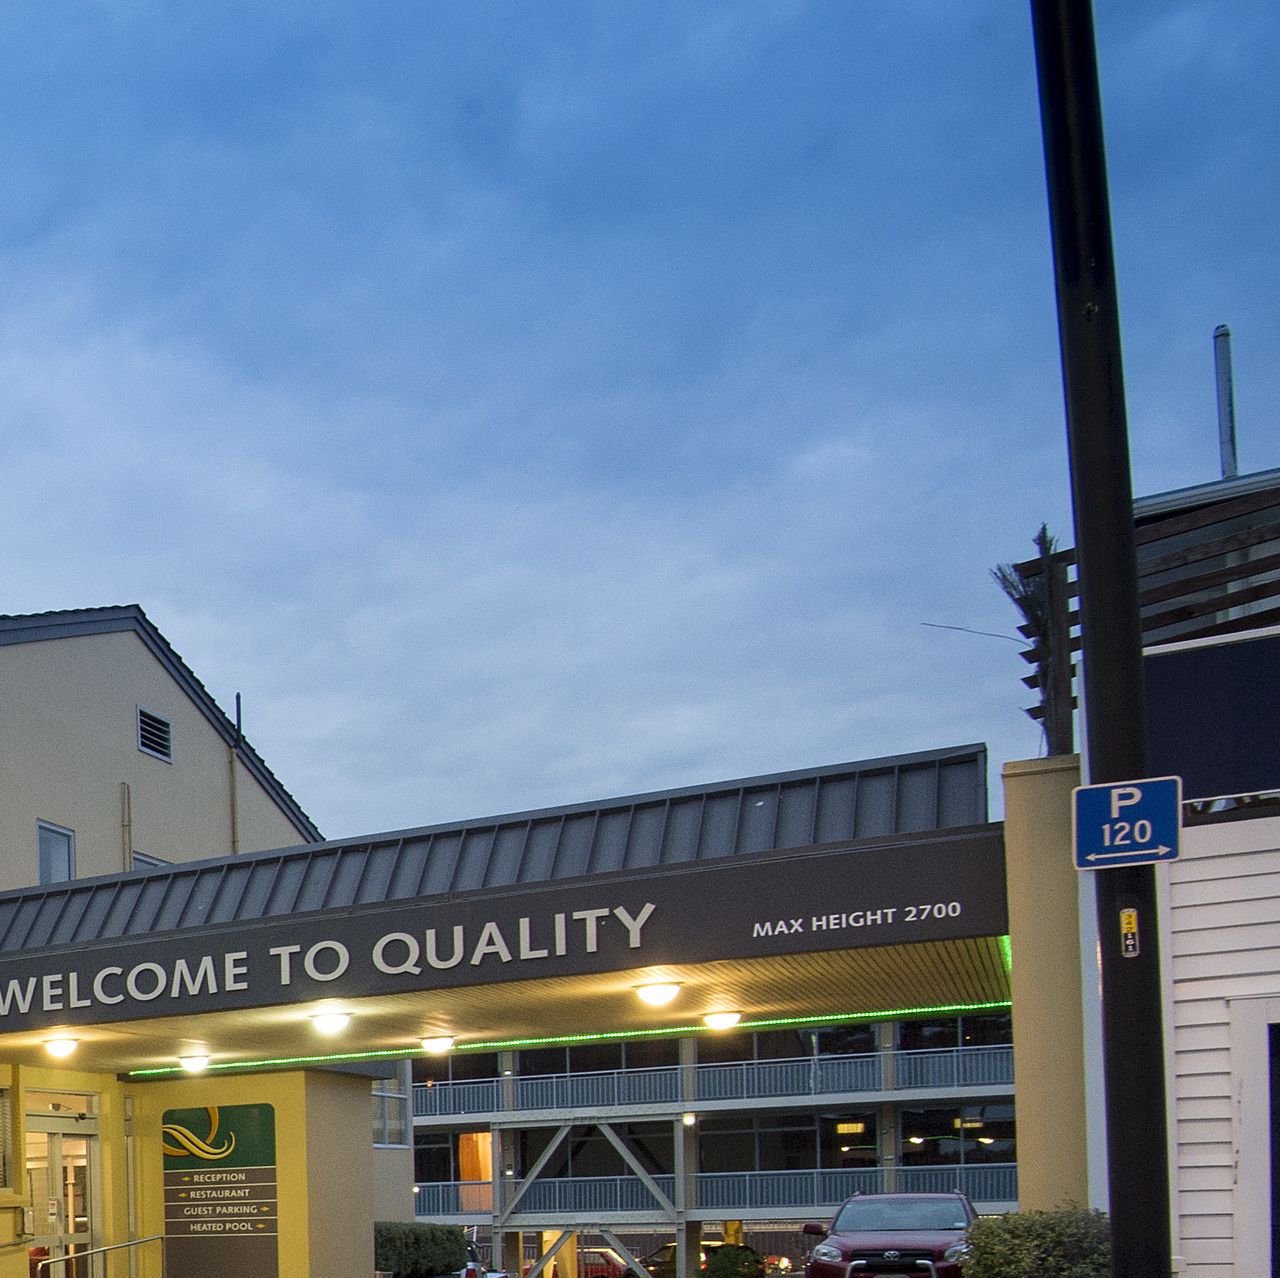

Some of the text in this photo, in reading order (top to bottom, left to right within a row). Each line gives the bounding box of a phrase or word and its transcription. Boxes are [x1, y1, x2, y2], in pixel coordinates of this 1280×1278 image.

[1111, 787, 1142, 819] P
[1102, 819, 1152, 846] 120
[752, 901, 962, 938] MAX HEIGHT 2700
[269, 940, 350, 986] TO
[372, 902, 656, 976] QUALITY
[193, 1173, 246, 1183] RECEPTION
[190, 1189, 250, 1199] RESTAURANT
[183, 1205, 258, 1215] GUEST PARKING
[190, 1222, 254, 1232] HEATED POOL
